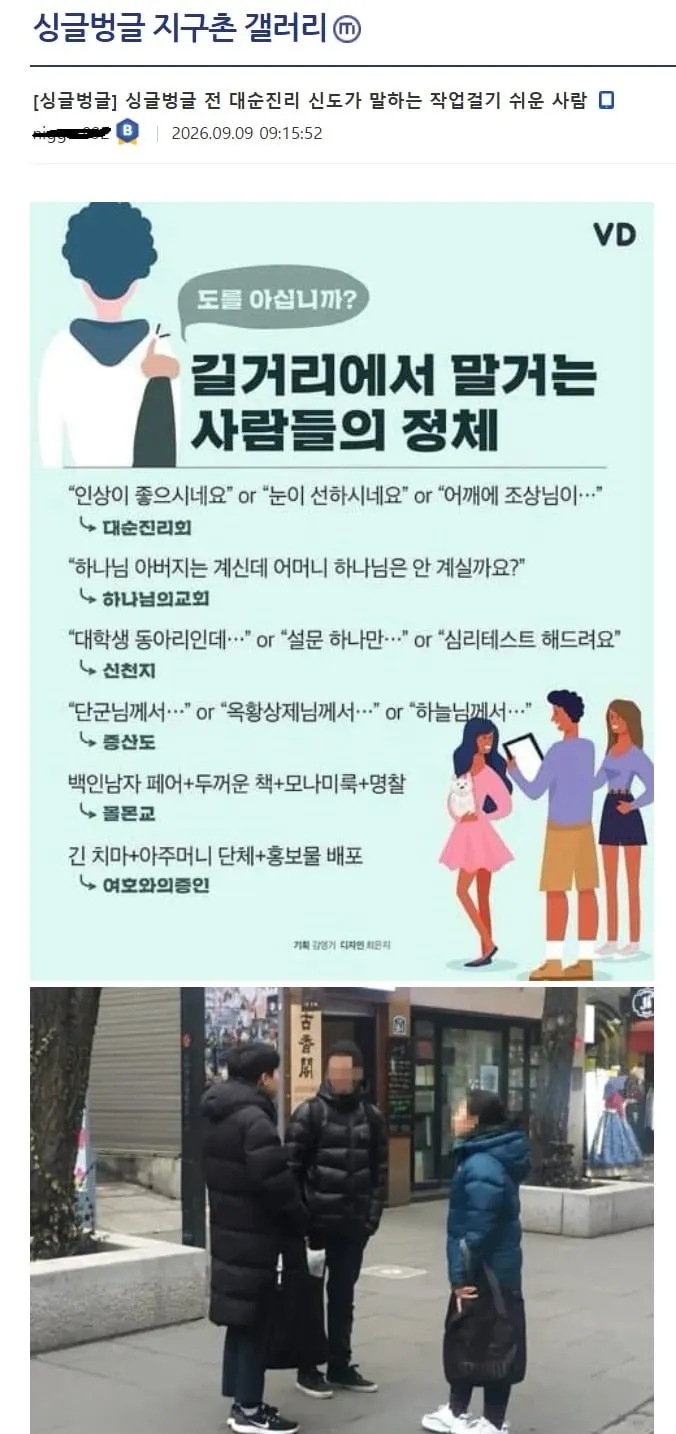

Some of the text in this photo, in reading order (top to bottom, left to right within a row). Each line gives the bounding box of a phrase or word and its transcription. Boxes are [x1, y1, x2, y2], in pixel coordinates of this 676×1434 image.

[593, 222, 636, 246] VD
[198, 289, 357, 310] 도를 아십니까?
[190, 353, 598, 396] 길거리에서 말거는
[190, 409, 498, 452] 사람들의 정체
[239, 491, 256, 504] or
[414, 491, 432, 504] or
[103, 520, 191, 536] 대순진리회
[135, 557, 208, 578] 아버지는
[214, 557, 267, 578] 계신데
[274, 557, 327, 578] 어머니
[334, 557, 407, 578] 하나님은
[413, 557, 431, 578] 안
[103, 591, 209, 607] 하나님의교회
[257, 635, 275, 648] or
[414, 635, 432, 648] or
[103, 663, 155, 679] 신천지
[196, 707, 215, 720] or
[386, 707, 404, 720] or
[103, 734, 155, 751] 증산도
[69, 773, 406, 794] 백인남자 페어+두꺼운 책+모나미룩+명찰
[103, 806, 155, 821] 몰몬교
[69, 845, 363, 866] 긴 치마+아주머니 단체+홍보물 배포
[103, 878, 209, 894] 여호와의증인
